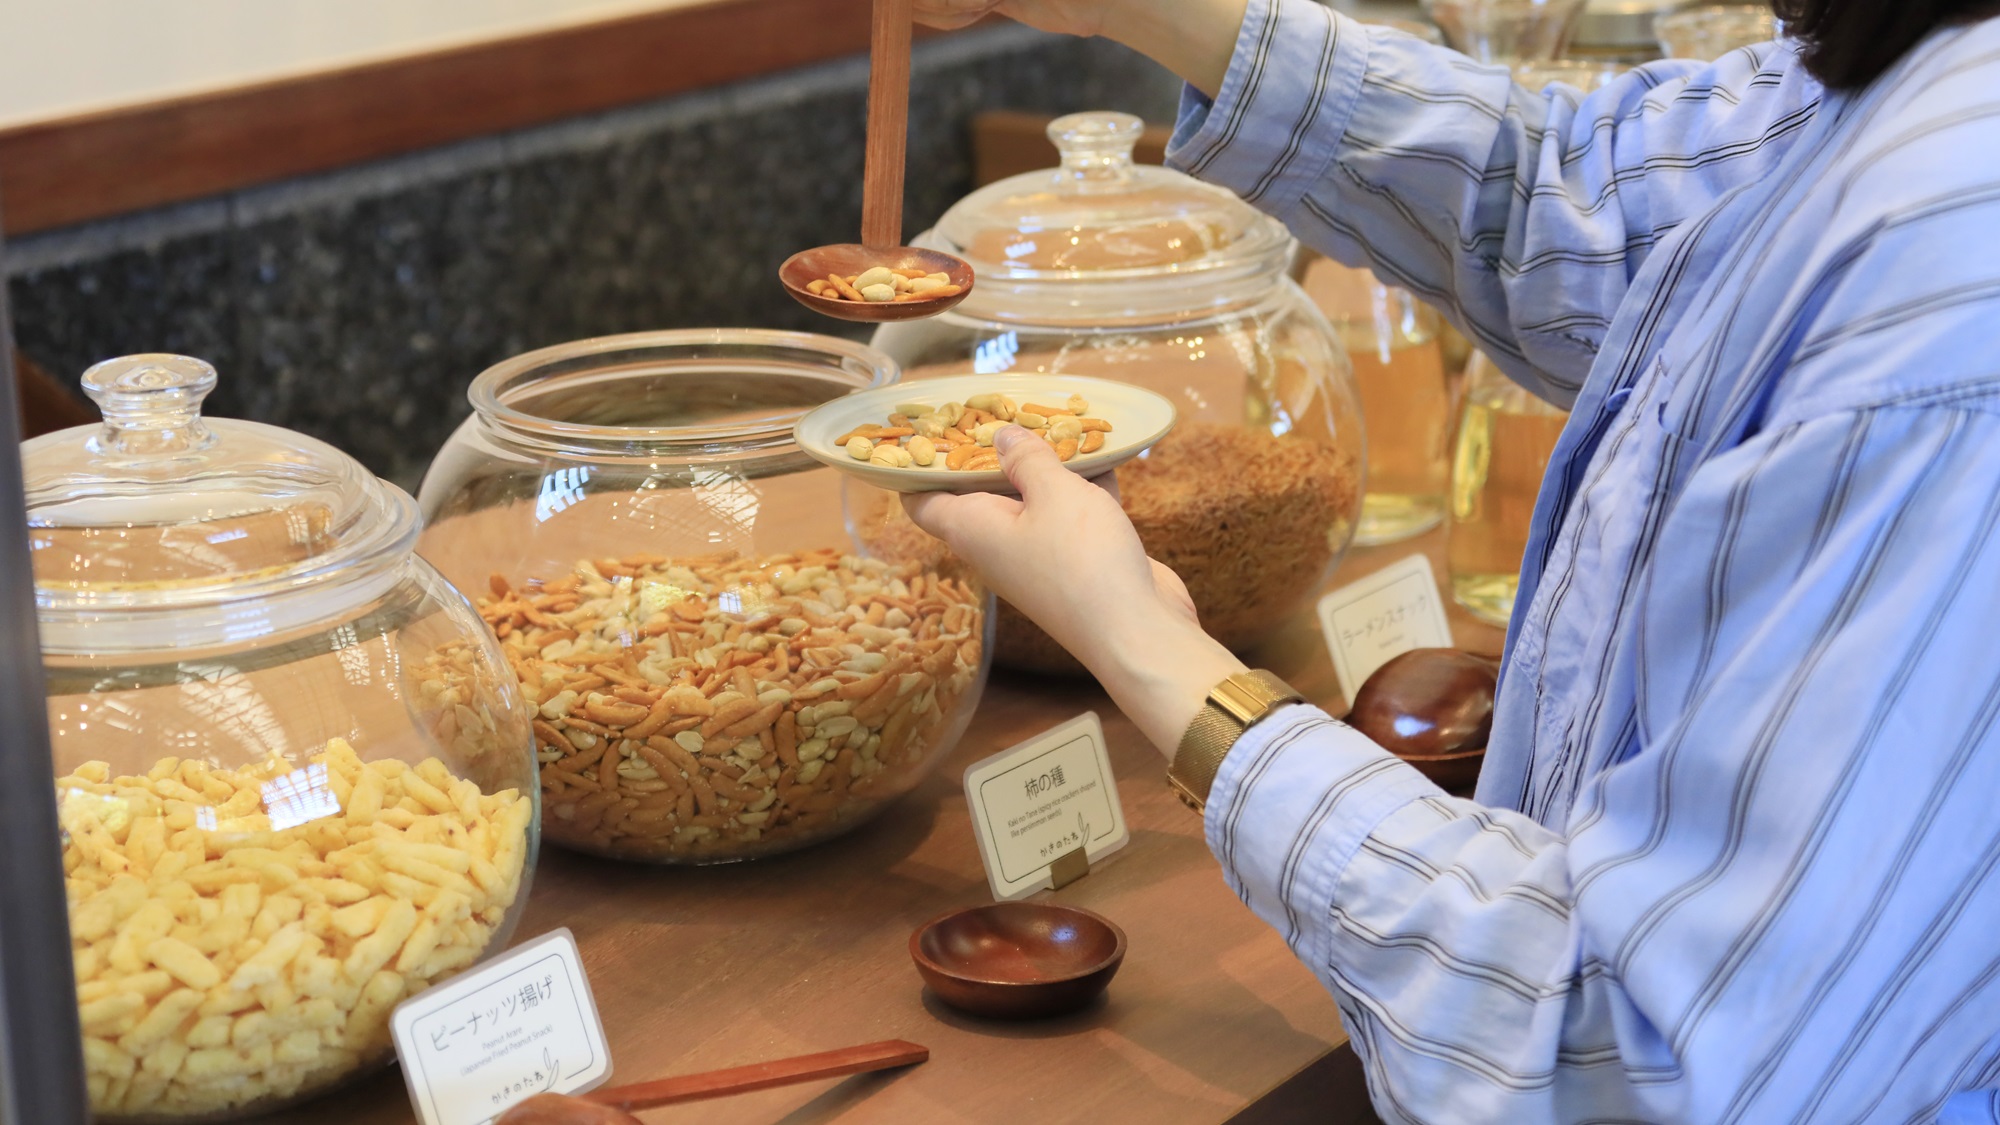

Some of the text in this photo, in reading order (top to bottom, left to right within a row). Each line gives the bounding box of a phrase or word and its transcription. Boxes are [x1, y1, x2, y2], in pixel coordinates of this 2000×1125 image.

[1024, 764, 1067, 800] 柿の種
[1007, 817, 1019, 828] Kaki
[1025, 810, 1038, 819] Tane
[1040, 831, 1079, 857] かきのたね
[430, 975, 554, 1051] ピーナッツ揚げ
[482, 1035, 505, 1050] Peanut
[508, 1035, 532, 1051] Peanut
[491, 1071, 544, 1104] かきのたね
